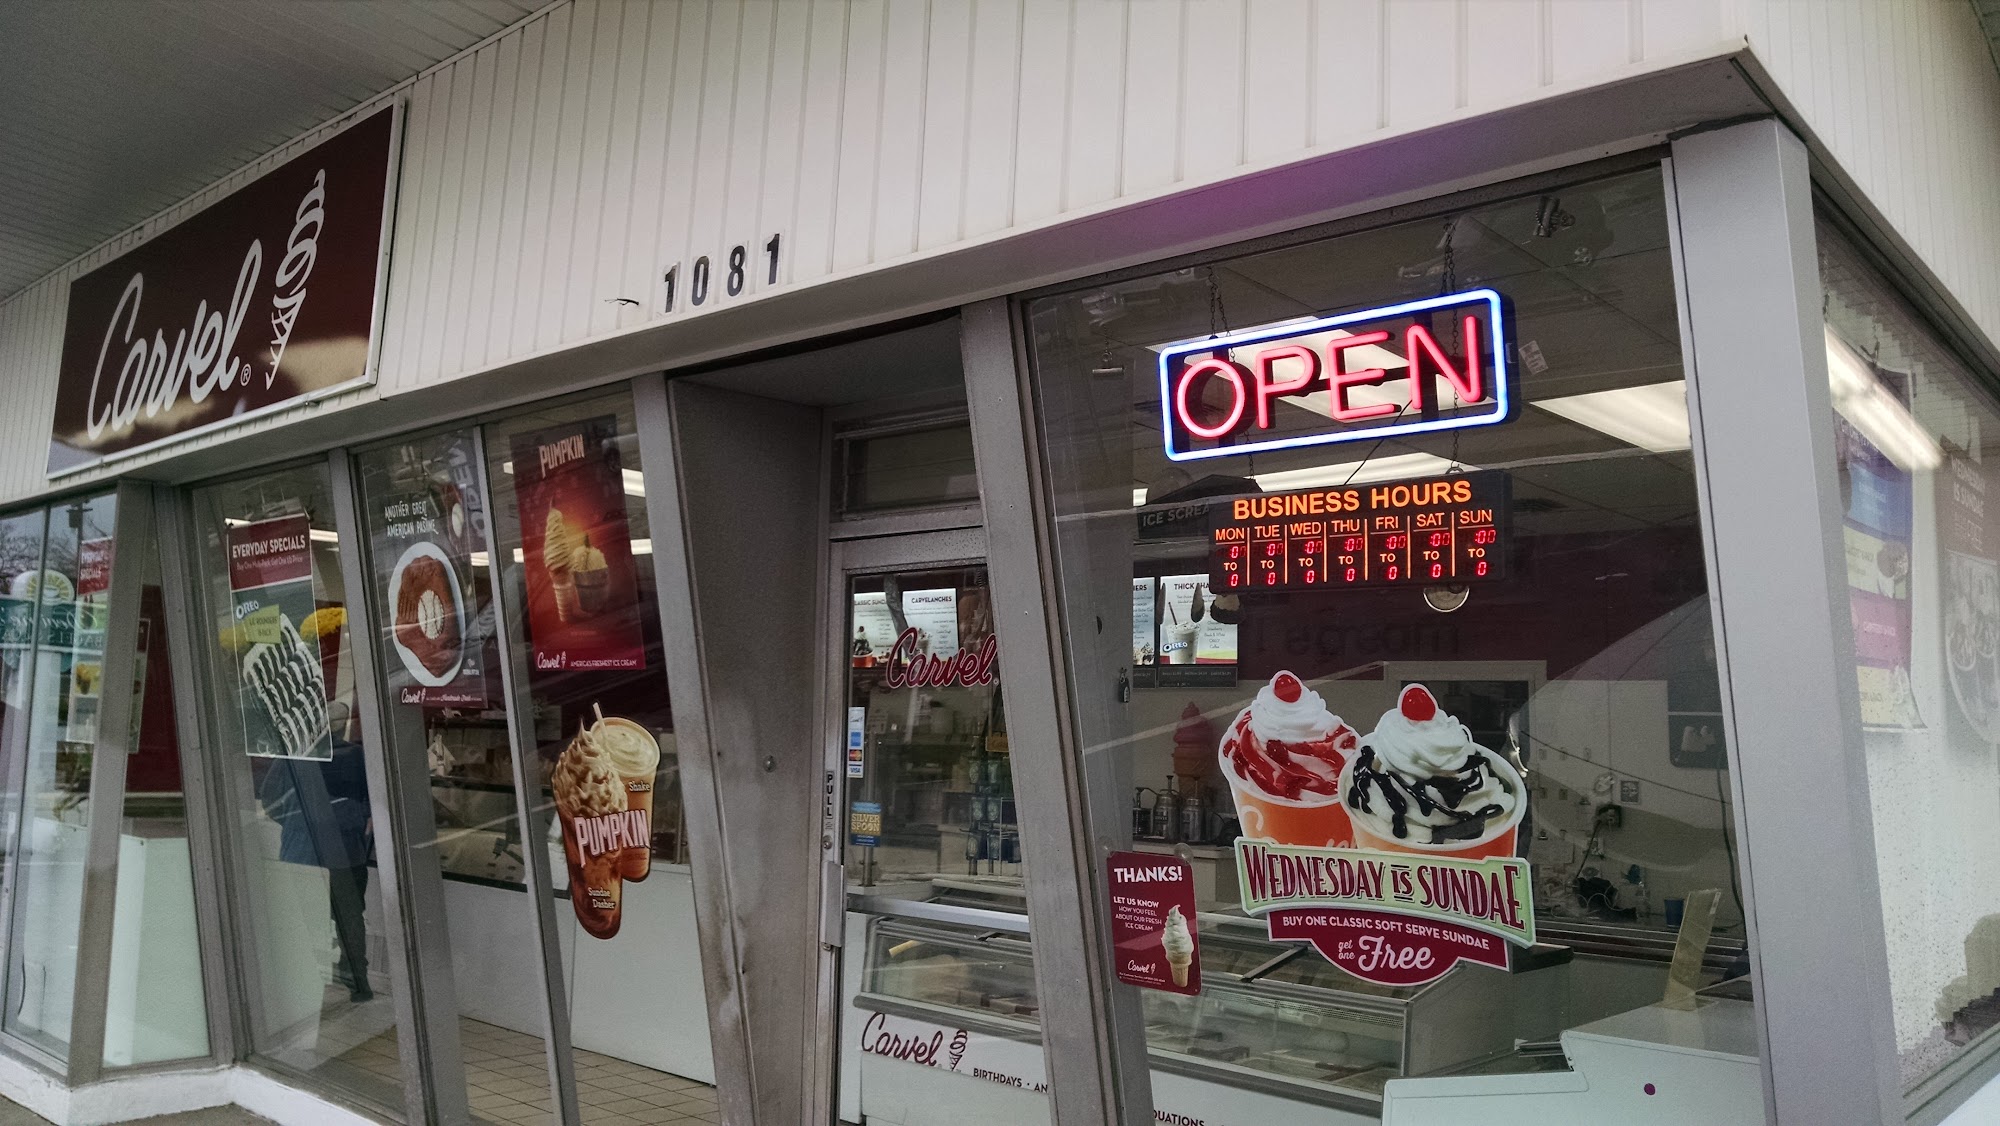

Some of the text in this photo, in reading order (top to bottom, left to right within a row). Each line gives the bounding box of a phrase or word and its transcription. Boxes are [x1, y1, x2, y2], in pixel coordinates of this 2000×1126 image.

[664, 233, 782, 313] 1081
[87, 239, 262, 440] Carvel
[1176, 315, 1481, 439] OPEN
[539, 434, 585, 478] PUMPKIN
[1234, 480, 1472, 520] BUSINESS HOURS
[384, 500, 428, 521] ANOTHER GREAT
[1143, 503, 1210, 527] ICE SCREA
[387, 522, 414, 538] AMERICAN
[1215, 509, 1492, 541] MON TUE WED THU FRI SAT SUN
[232, 534, 306, 558] EVERYDAY SPECIALS
[1224, 548, 1485, 571] TO TO TO TO TO TO TO
[236, 600, 259, 619] OREO
[911, 596, 952, 604] CARVELANCHES
[1163, 642, 1188, 652] OREO
[537, 651, 560, 670] Carvel
[886, 626, 998, 689] Carvel
[401, 687, 421, 704] Carvel
[629, 781, 650, 792] Shake
[851, 822, 880, 832] SPOON
[852, 813, 880, 823] SILVER
[574, 809, 651, 868] PUMPKIN
[1114, 866, 1183, 883] THANKS!
[588, 887, 611, 898] Sundae
[1242, 844, 1526, 931] WEDNESDAY IS SUNDAE
[592, 899, 615, 910] Dasher
[1113, 896, 1126, 904] LET
[1137, 899, 1159, 908] KNOW
[1115, 913, 1162, 925] ABOUT OUR FRESH
[1145, 909, 1157, 917] FEEL
[1134, 923, 1153, 931] CREAM
[1283, 916, 1490, 950] BUY ONE CLASSIC SOFT SERVE SUNDAE
[1338, 940, 1353, 953] get
[1338, 950, 1355, 960] one
[1357, 935, 1435, 972] Free
[1127, 960, 1149, 973] Carvel
[861, 1011, 943, 1067] Carvel
[973, 1067, 1022, 1087] BIRTHDAYS
